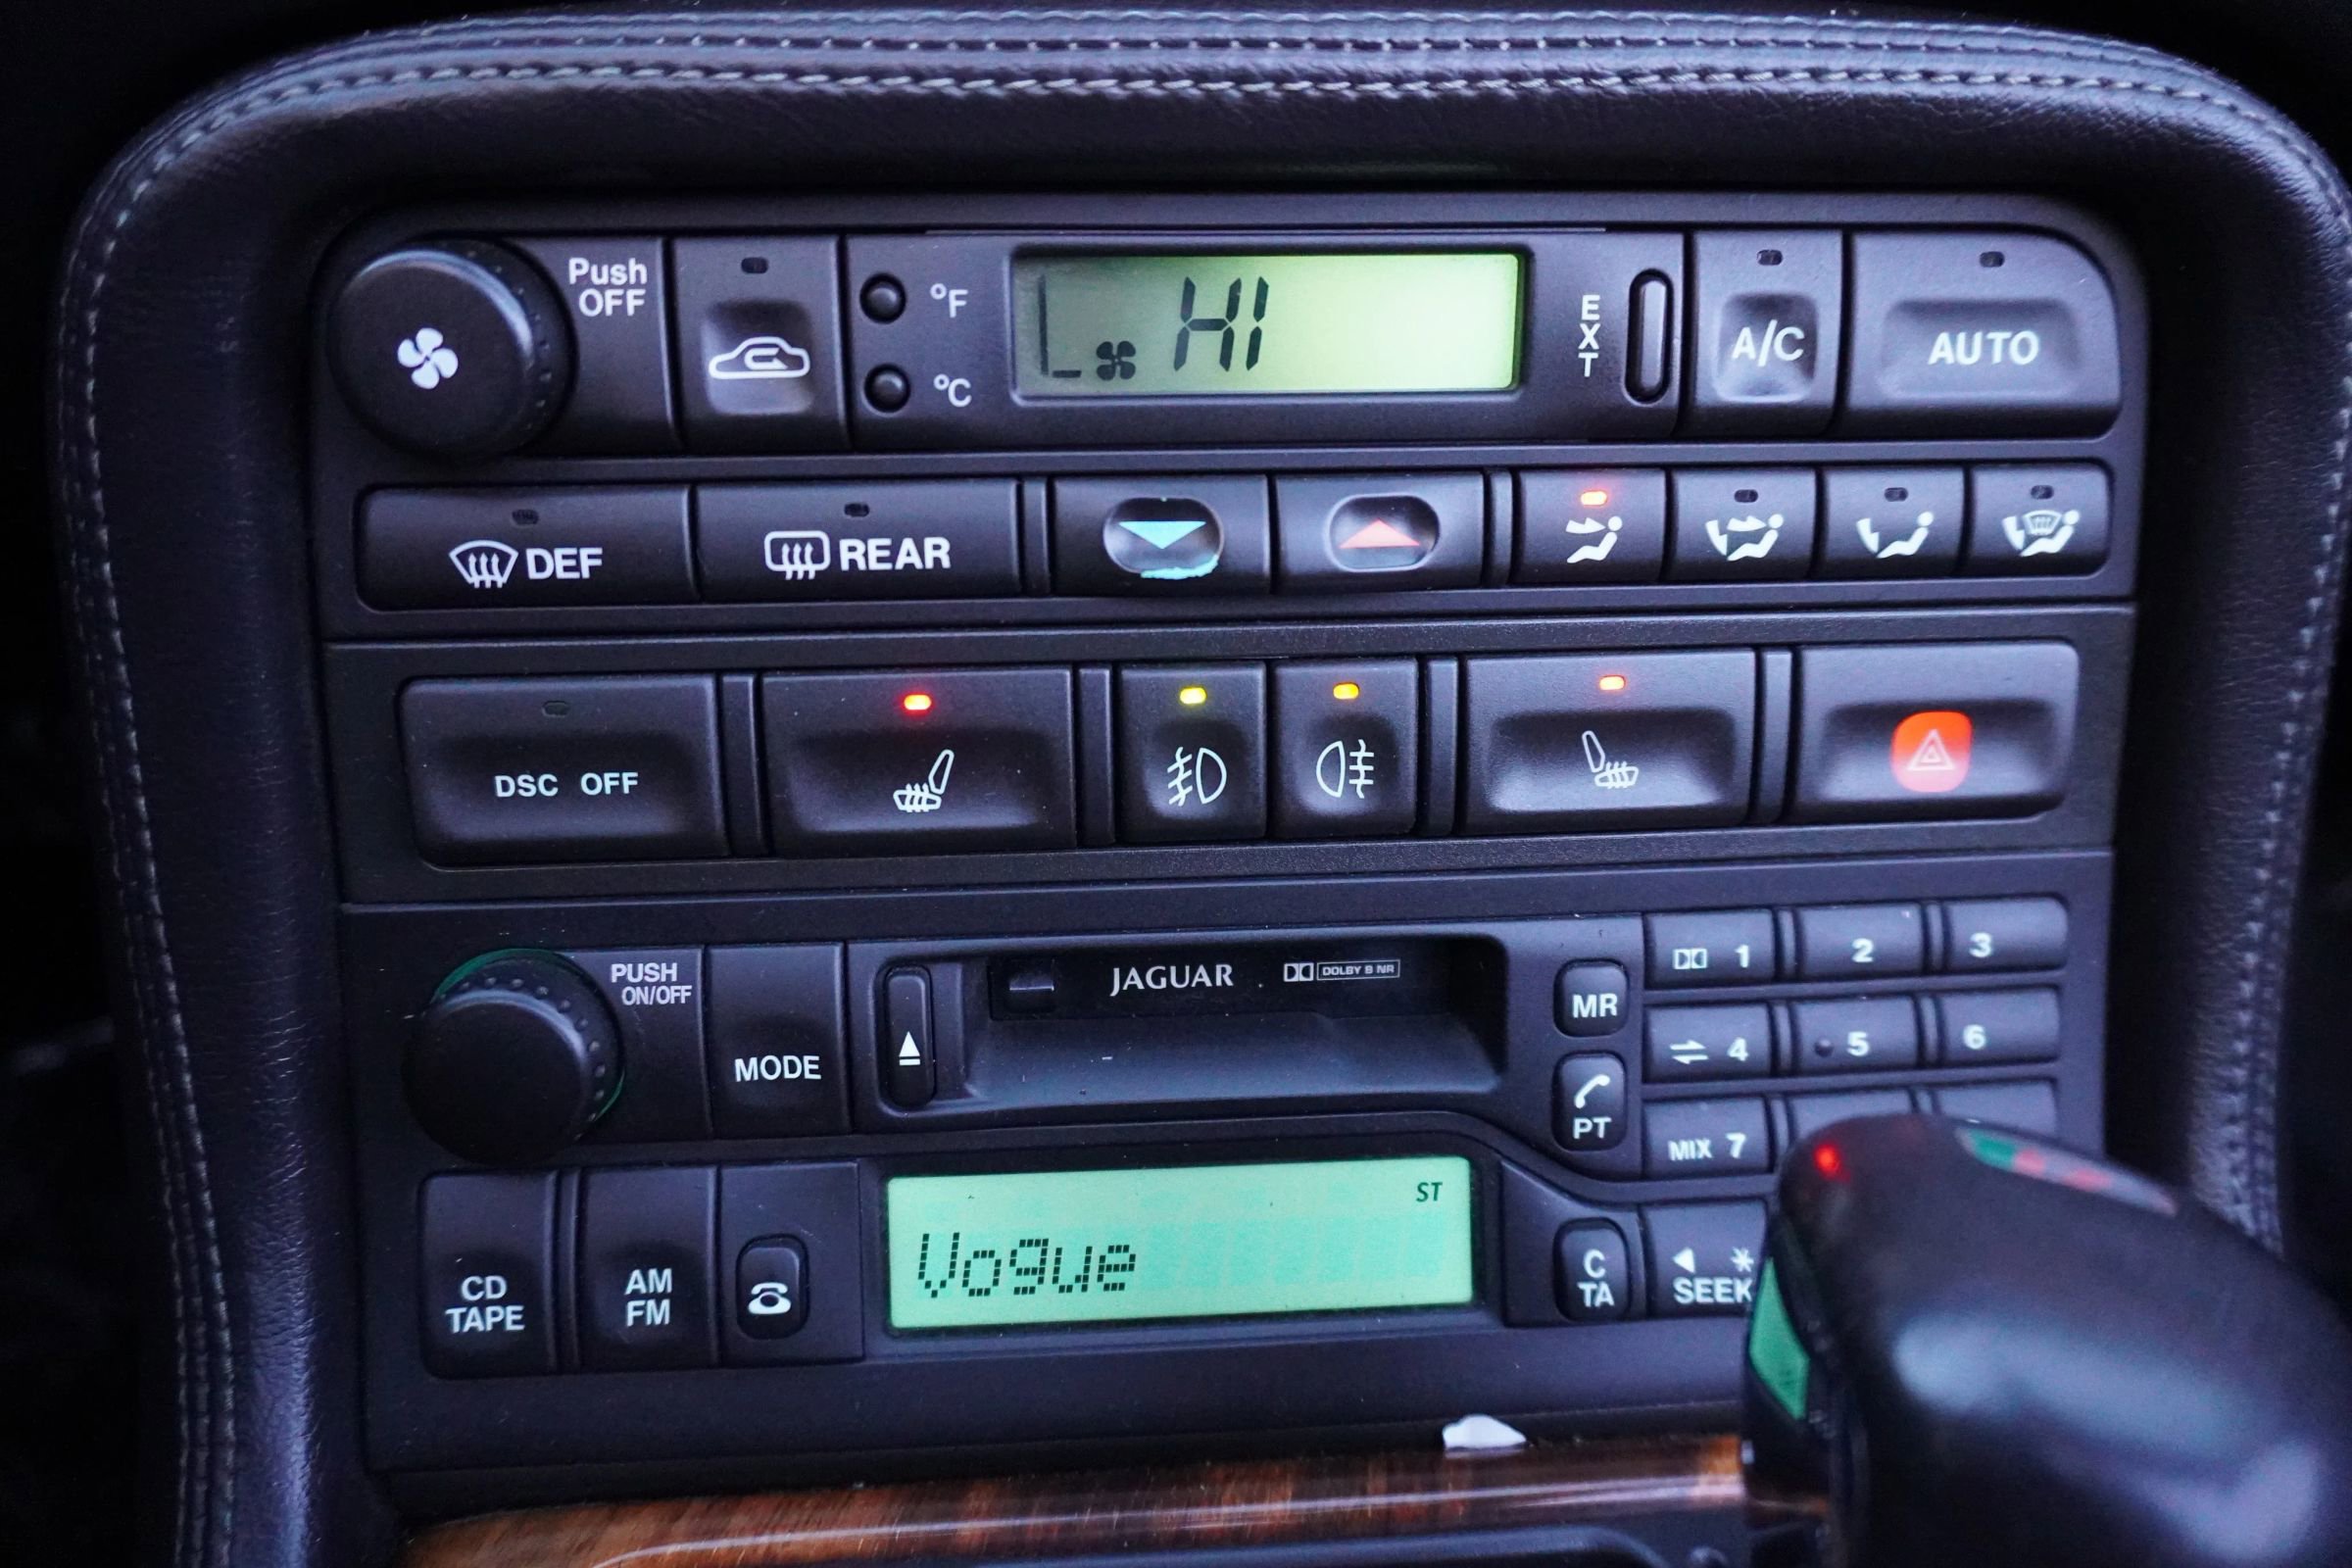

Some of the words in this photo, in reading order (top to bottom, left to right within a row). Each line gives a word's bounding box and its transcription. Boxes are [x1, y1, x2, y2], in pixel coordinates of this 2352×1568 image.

[568, 258, 647, 285] Push
[578, 289, 647, 317] OFF
[1173, 275, 1270, 372] HI
[1578, 294, 1601, 377] EXT
[1732, 319, 1805, 368] A/C
[1928, 330, 2039, 366] AUTO
[525, 547, 603, 581] DEF
[839, 537, 951, 572] REAR
[494, 773, 559, 799] DSC
[580, 771, 639, 797] OFF
[1736, 945, 1749, 969] 1
[1851, 938, 1874, 962] 2
[1970, 932, 1992, 957] 3
[611, 962, 678, 985] PUSH
[1109, 962, 1234, 997] JAGUAR
[1322, 965, 1361, 976] DOLBY
[1364, 964, 1373, 975] B
[1376, 964, 1395, 974] NR
[621, 985, 693, 1007] ON/OFF
[1572, 993, 1619, 1018] MR
[1728, 1038, 1748, 1061] 4
[1847, 1032, 1870, 1056] 5
[1964, 1025, 1986, 1050] 6
[734, 1054, 822, 1083] MODE
[1573, 1117, 1612, 1140] PT
[1669, 1139, 1712, 1161] MIX
[1728, 1133, 1746, 1158] 7
[1416, 1181, 1443, 1202] ST
[917, 1232, 1136, 1298] Vogue
[1583, 1250, 1605, 1278] C
[461, 1276, 507, 1301] CD
[624, 1268, 672, 1295] AM
[1578, 1282, 1614, 1307] TA
[1673, 1278, 1753, 1305] SEEK
[444, 1305, 525, 1333] TAPE
[626, 1298, 670, 1327] FM
